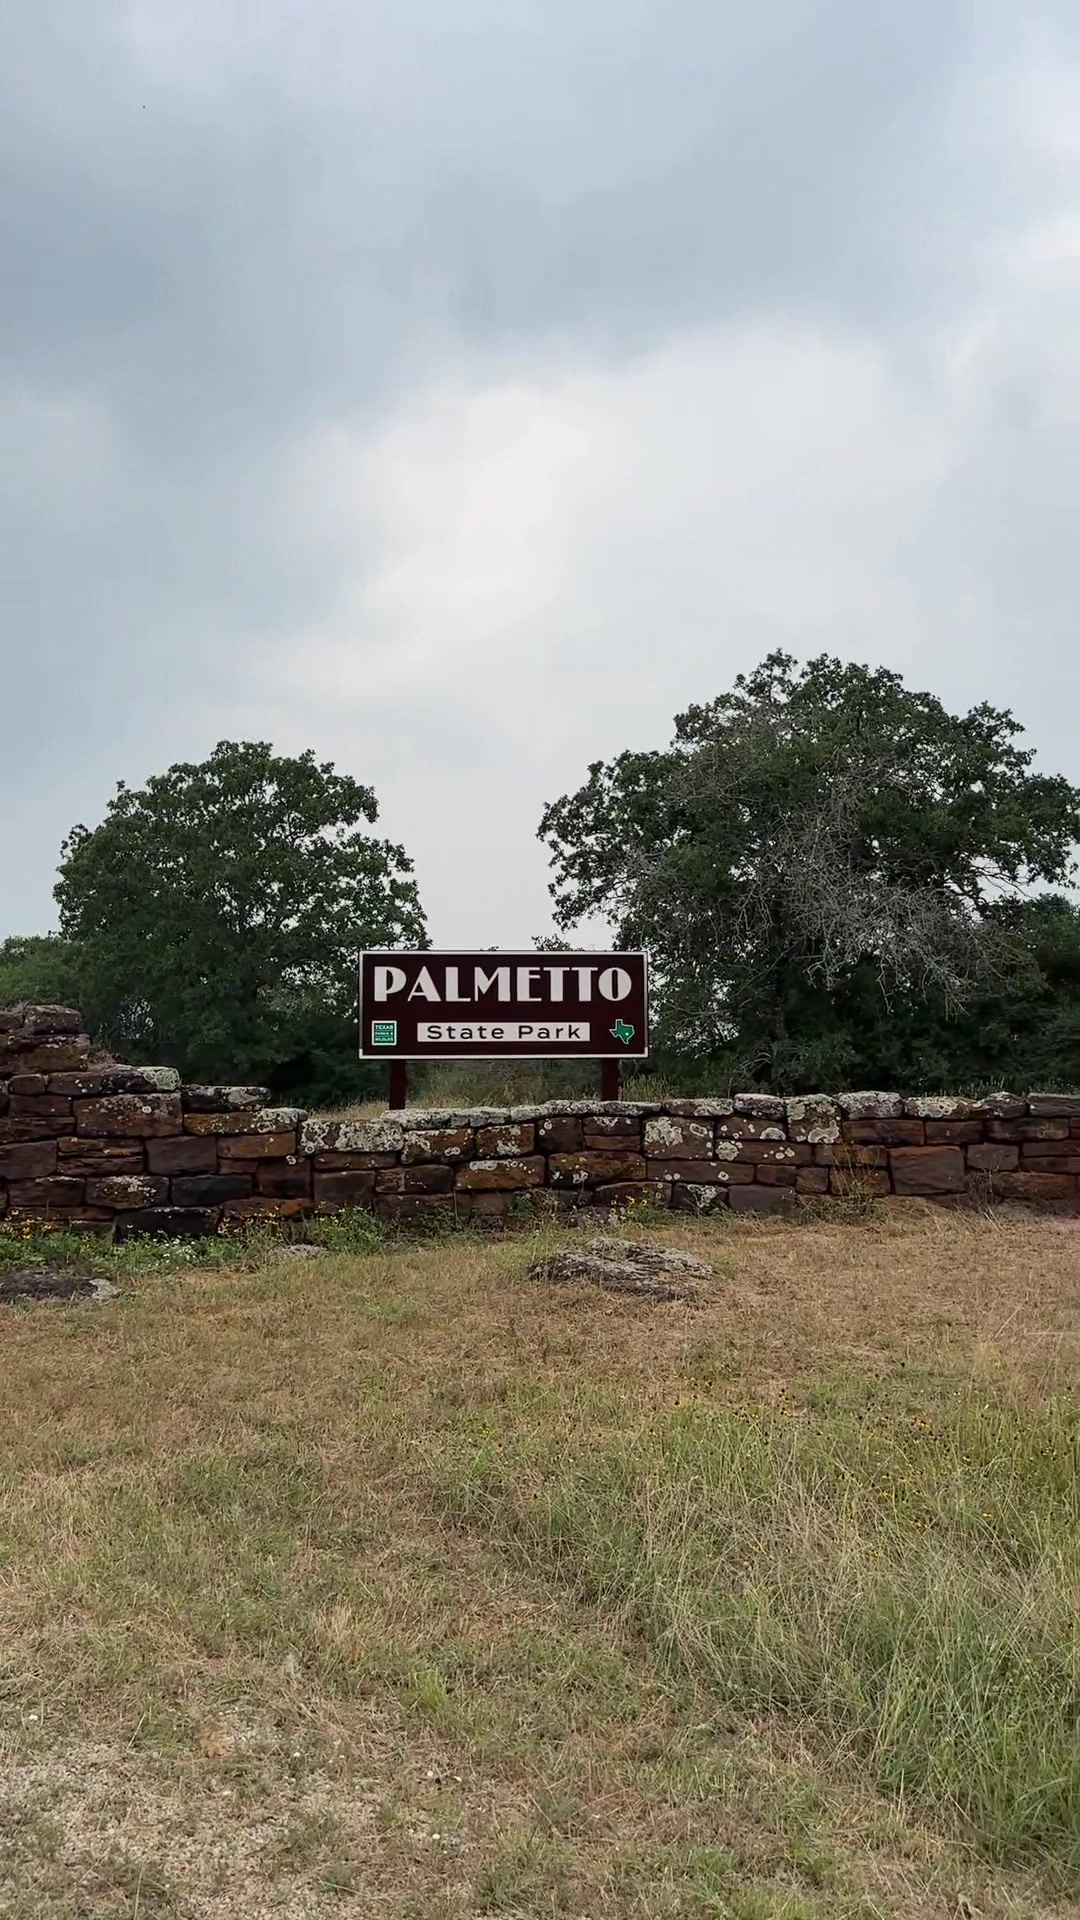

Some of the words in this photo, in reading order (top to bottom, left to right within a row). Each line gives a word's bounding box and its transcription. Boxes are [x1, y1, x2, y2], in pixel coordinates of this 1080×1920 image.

[374, 966, 632, 1002] PALMETTO
[427, 1025, 505, 1040] State
[518, 1025, 581, 1040] Park
